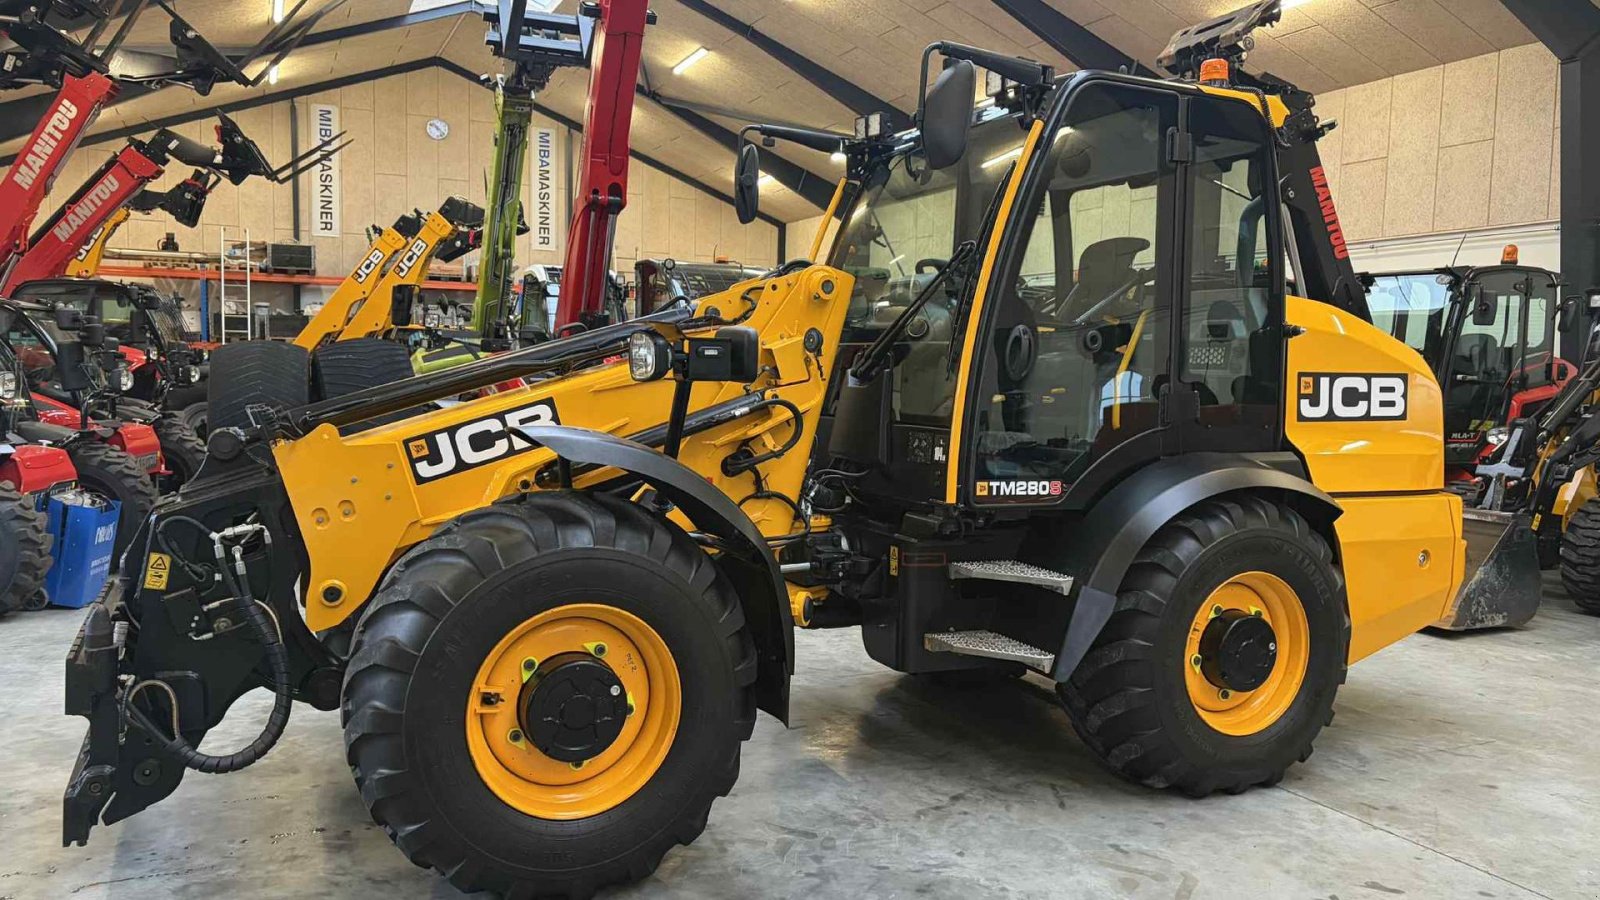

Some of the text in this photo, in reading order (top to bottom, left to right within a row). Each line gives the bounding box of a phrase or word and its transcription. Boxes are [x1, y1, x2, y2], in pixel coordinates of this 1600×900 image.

[13, 98, 78, 191] MANITOU
[53, 174, 119, 242] MANITOU
[538, 132, 550, 245] MIBAMASKINER
[1309, 165, 1349, 260] MANITOU
[356, 249, 384, 283] JCB
[398, 239, 427, 277] JCB
[1299, 376, 1405, 418] JCB
[989, 480, 1062, 496] TM280S
